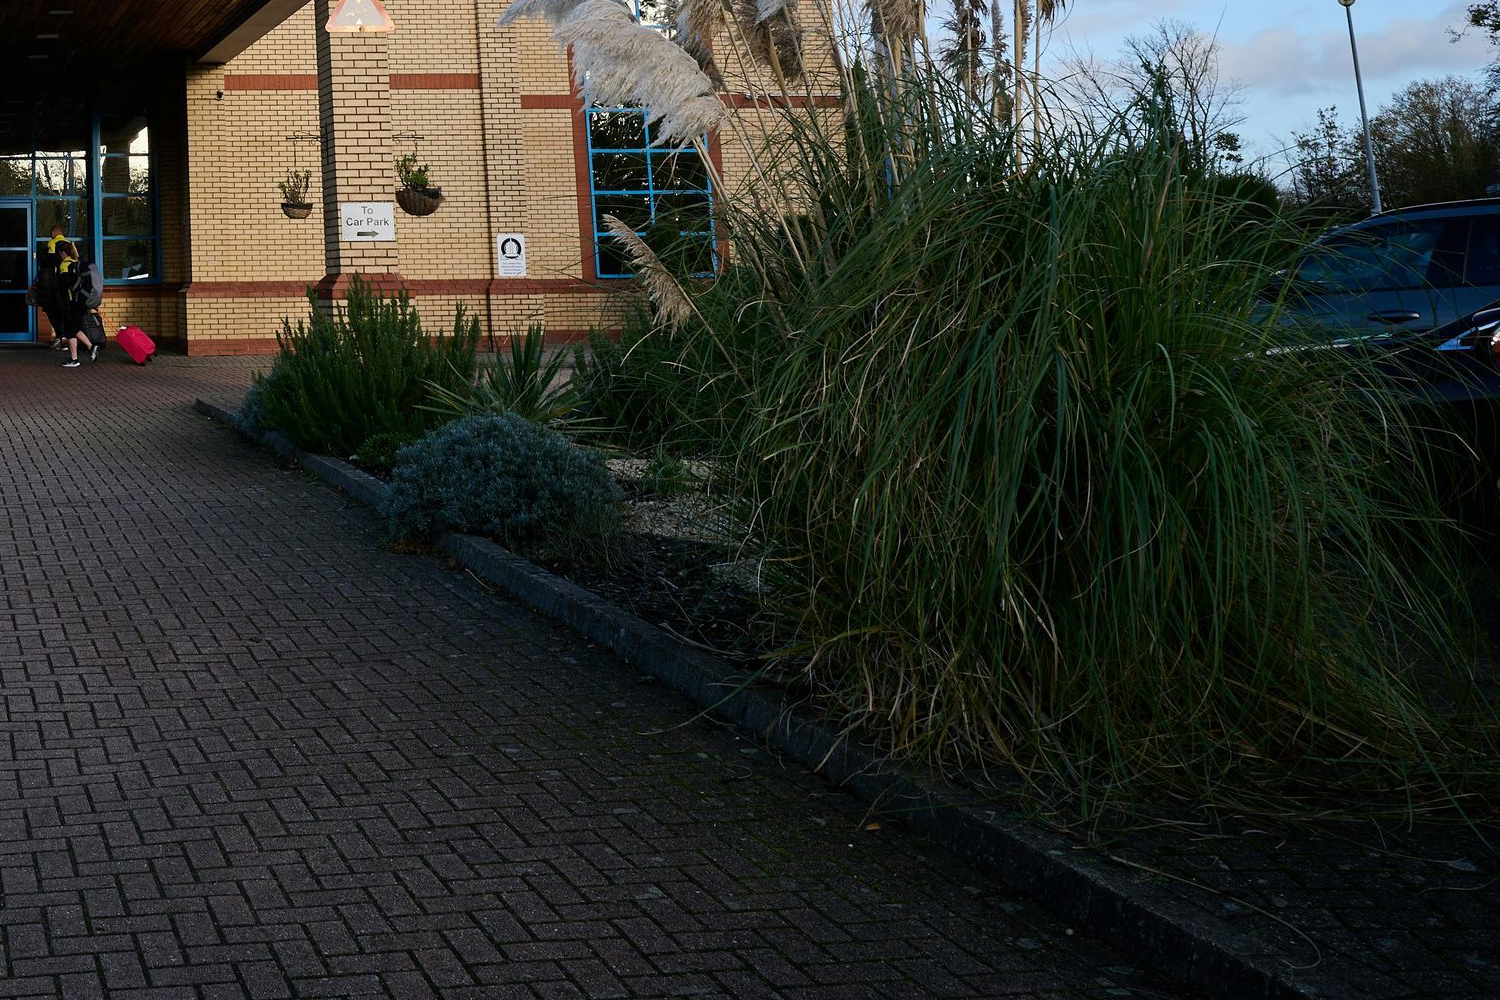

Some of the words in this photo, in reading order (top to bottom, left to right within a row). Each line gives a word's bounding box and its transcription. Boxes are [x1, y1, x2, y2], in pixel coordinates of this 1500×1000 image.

[361, 205, 374, 215] To
[345, 217, 364, 227] Car
[366, 217, 390, 226] Park
